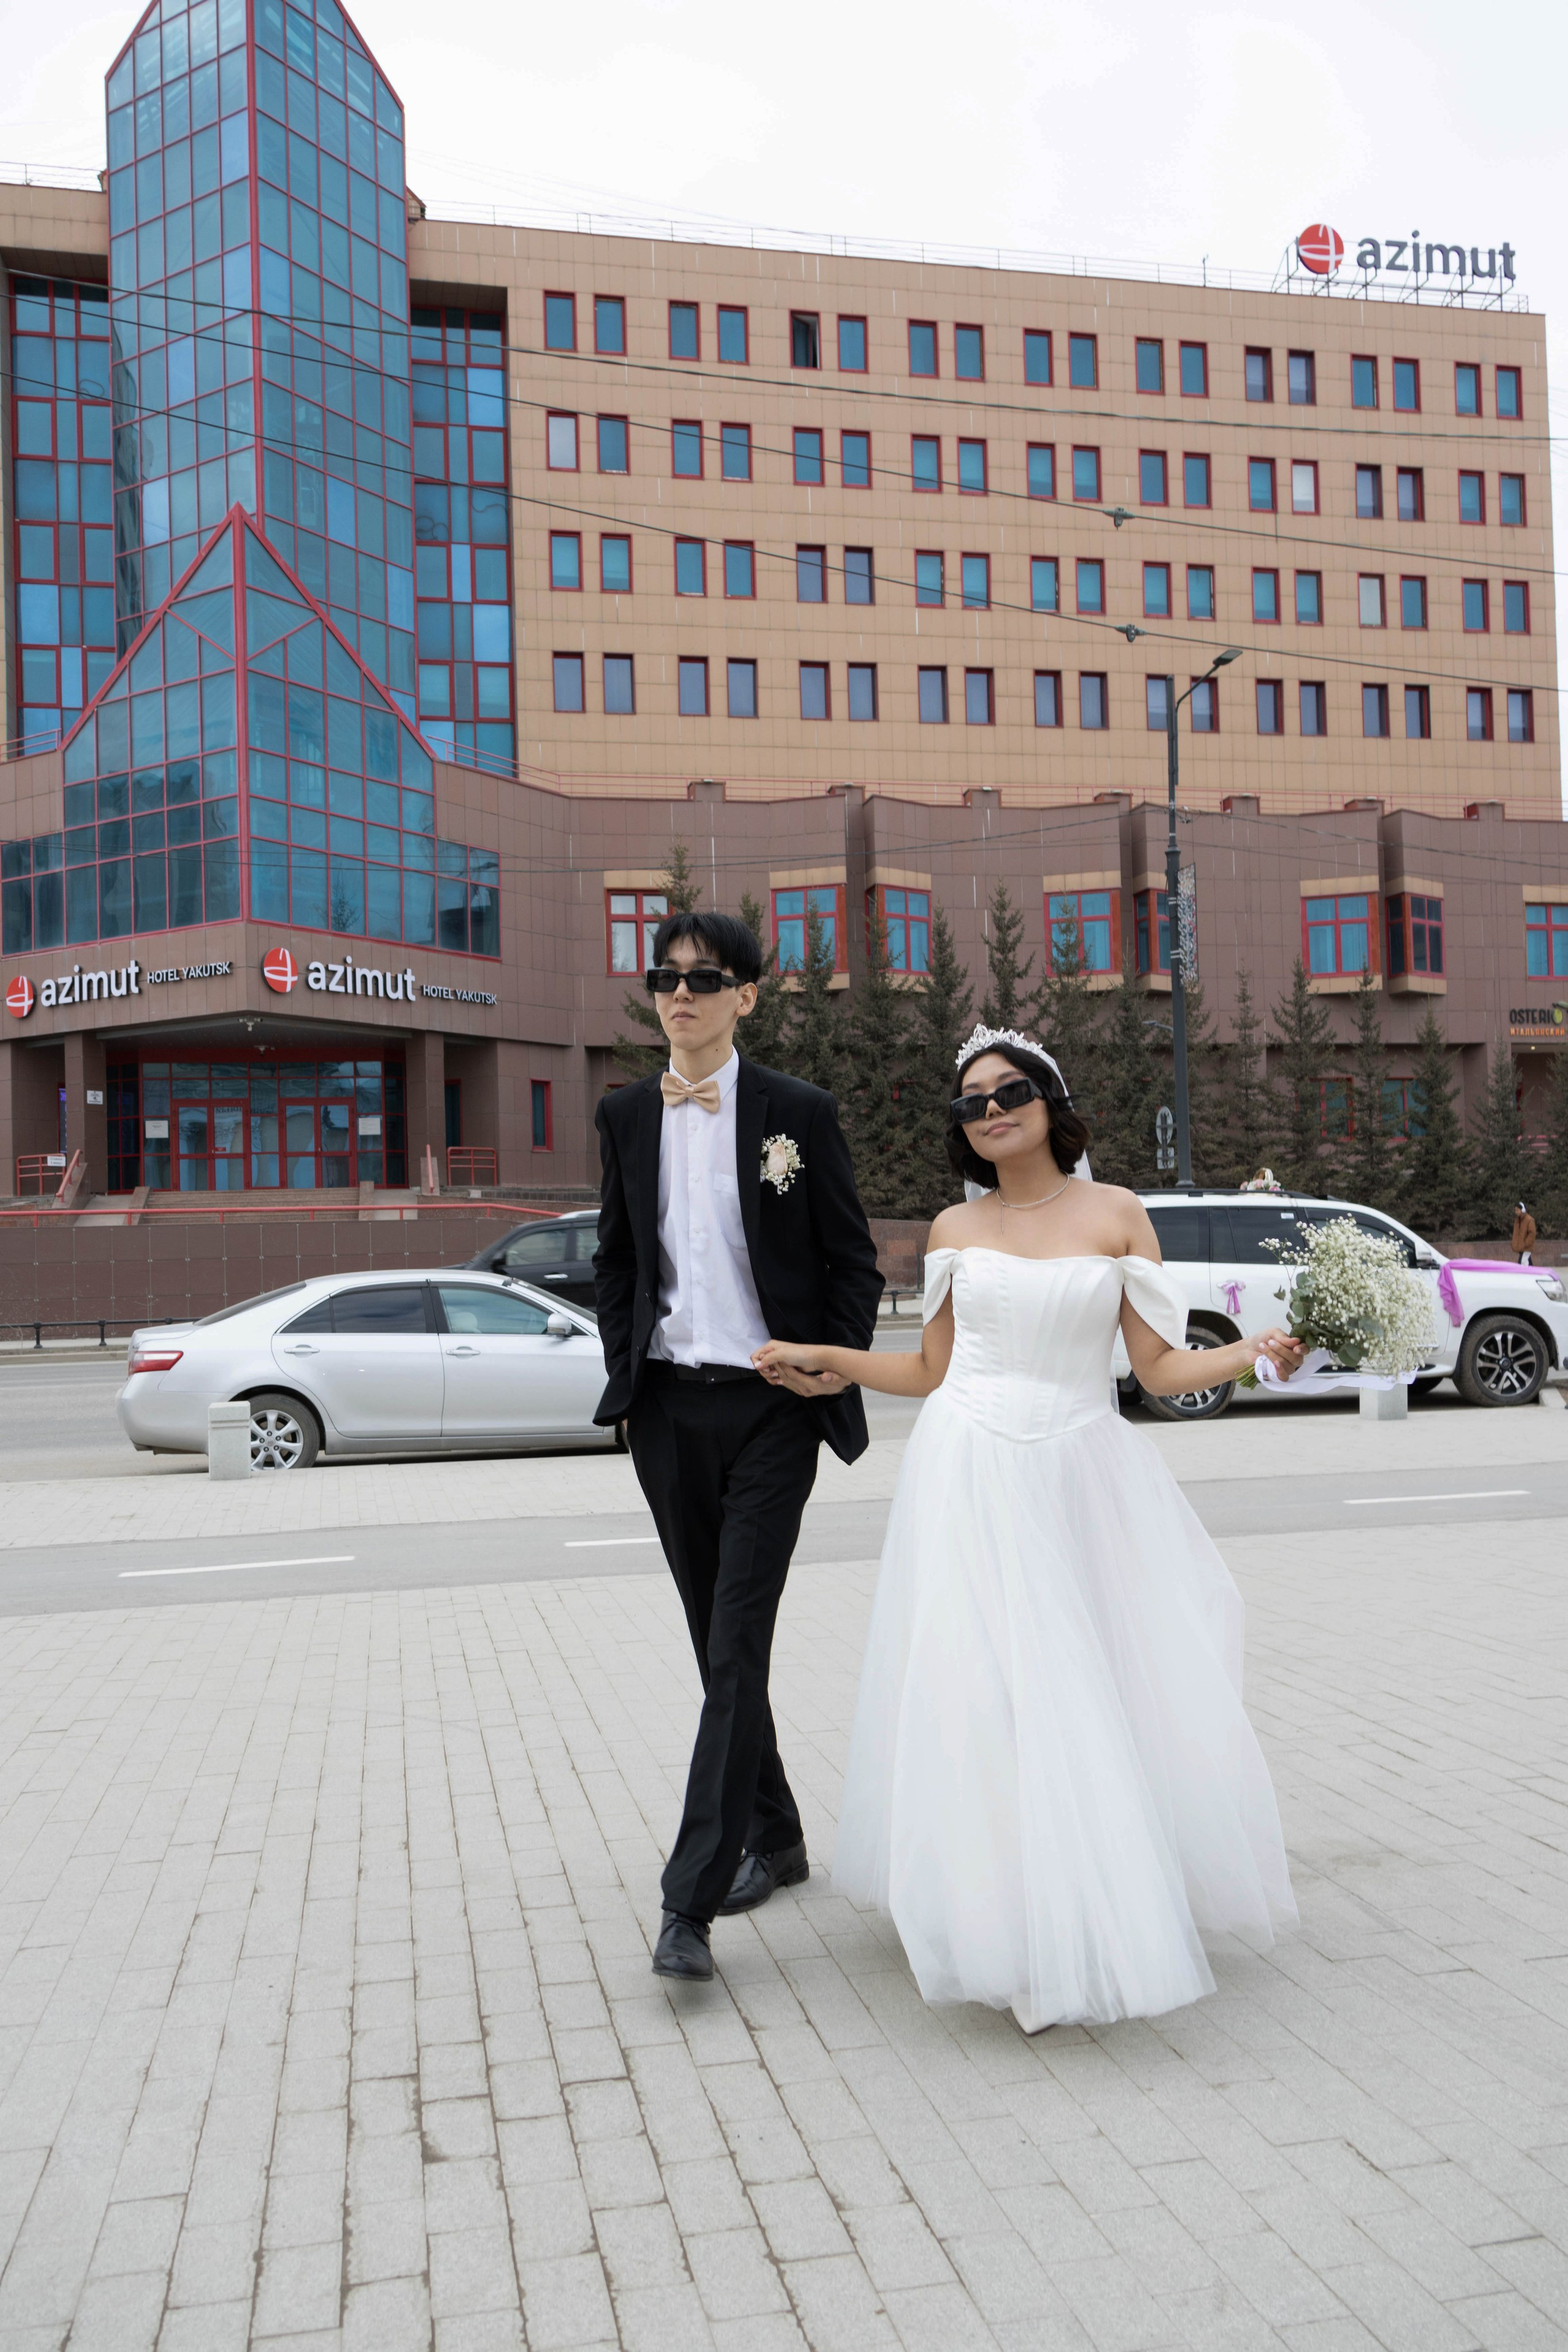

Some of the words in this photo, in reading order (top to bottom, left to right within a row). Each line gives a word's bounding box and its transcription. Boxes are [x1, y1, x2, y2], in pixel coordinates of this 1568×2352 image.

[1356, 230, 1516, 280] azimut
[40, 959, 140, 1007] azimut
[147, 968, 179, 983] HOTEL
[182, 961, 230, 979] YAKUTSK
[307, 956, 416, 1001] azimut
[423, 984, 454, 1000] HOTEL
[455, 989, 497, 1005] YAKUTSK
